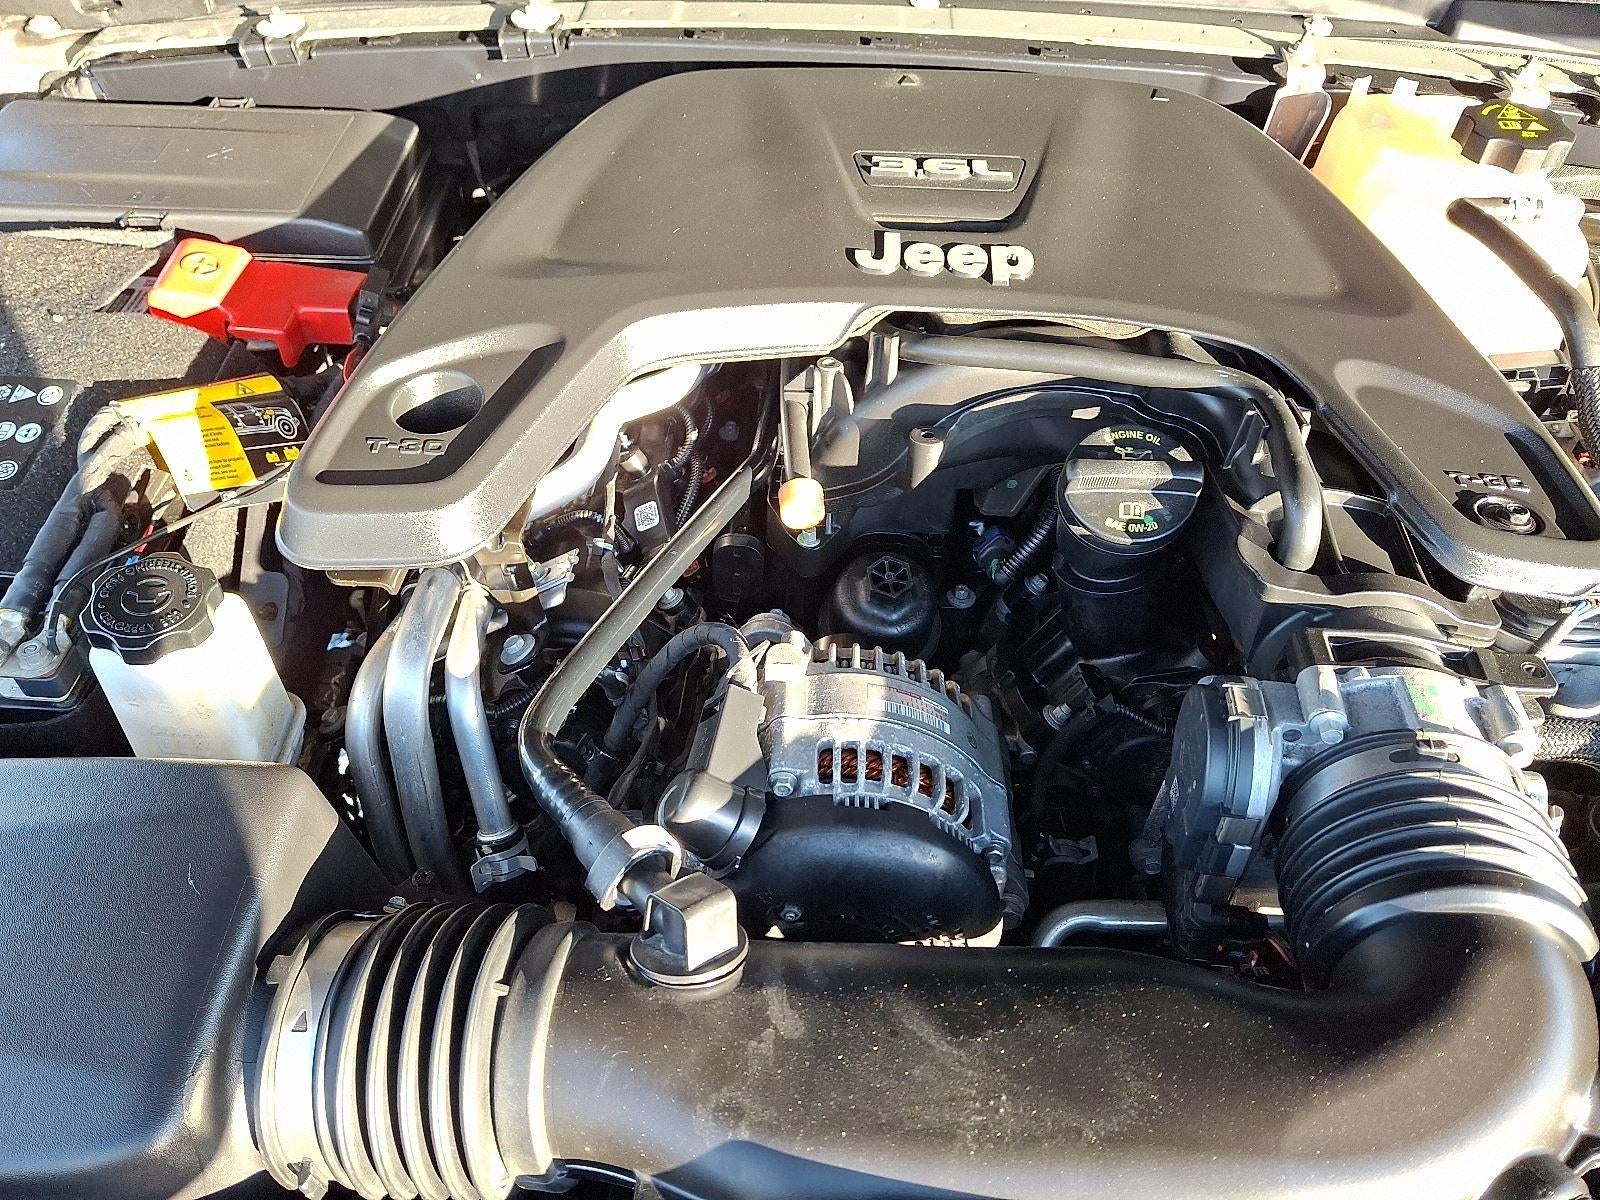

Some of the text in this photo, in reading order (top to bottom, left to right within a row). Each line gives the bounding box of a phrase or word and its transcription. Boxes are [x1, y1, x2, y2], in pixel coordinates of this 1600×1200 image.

[867, 155, 1014, 181] 3.6L
[853, 231, 1036, 286] Jeep
[1145, 433, 1161, 446] OIL
[1128, 522, 1158, 532] 0W-20
[99, 611, 157, 634] APPROVED
